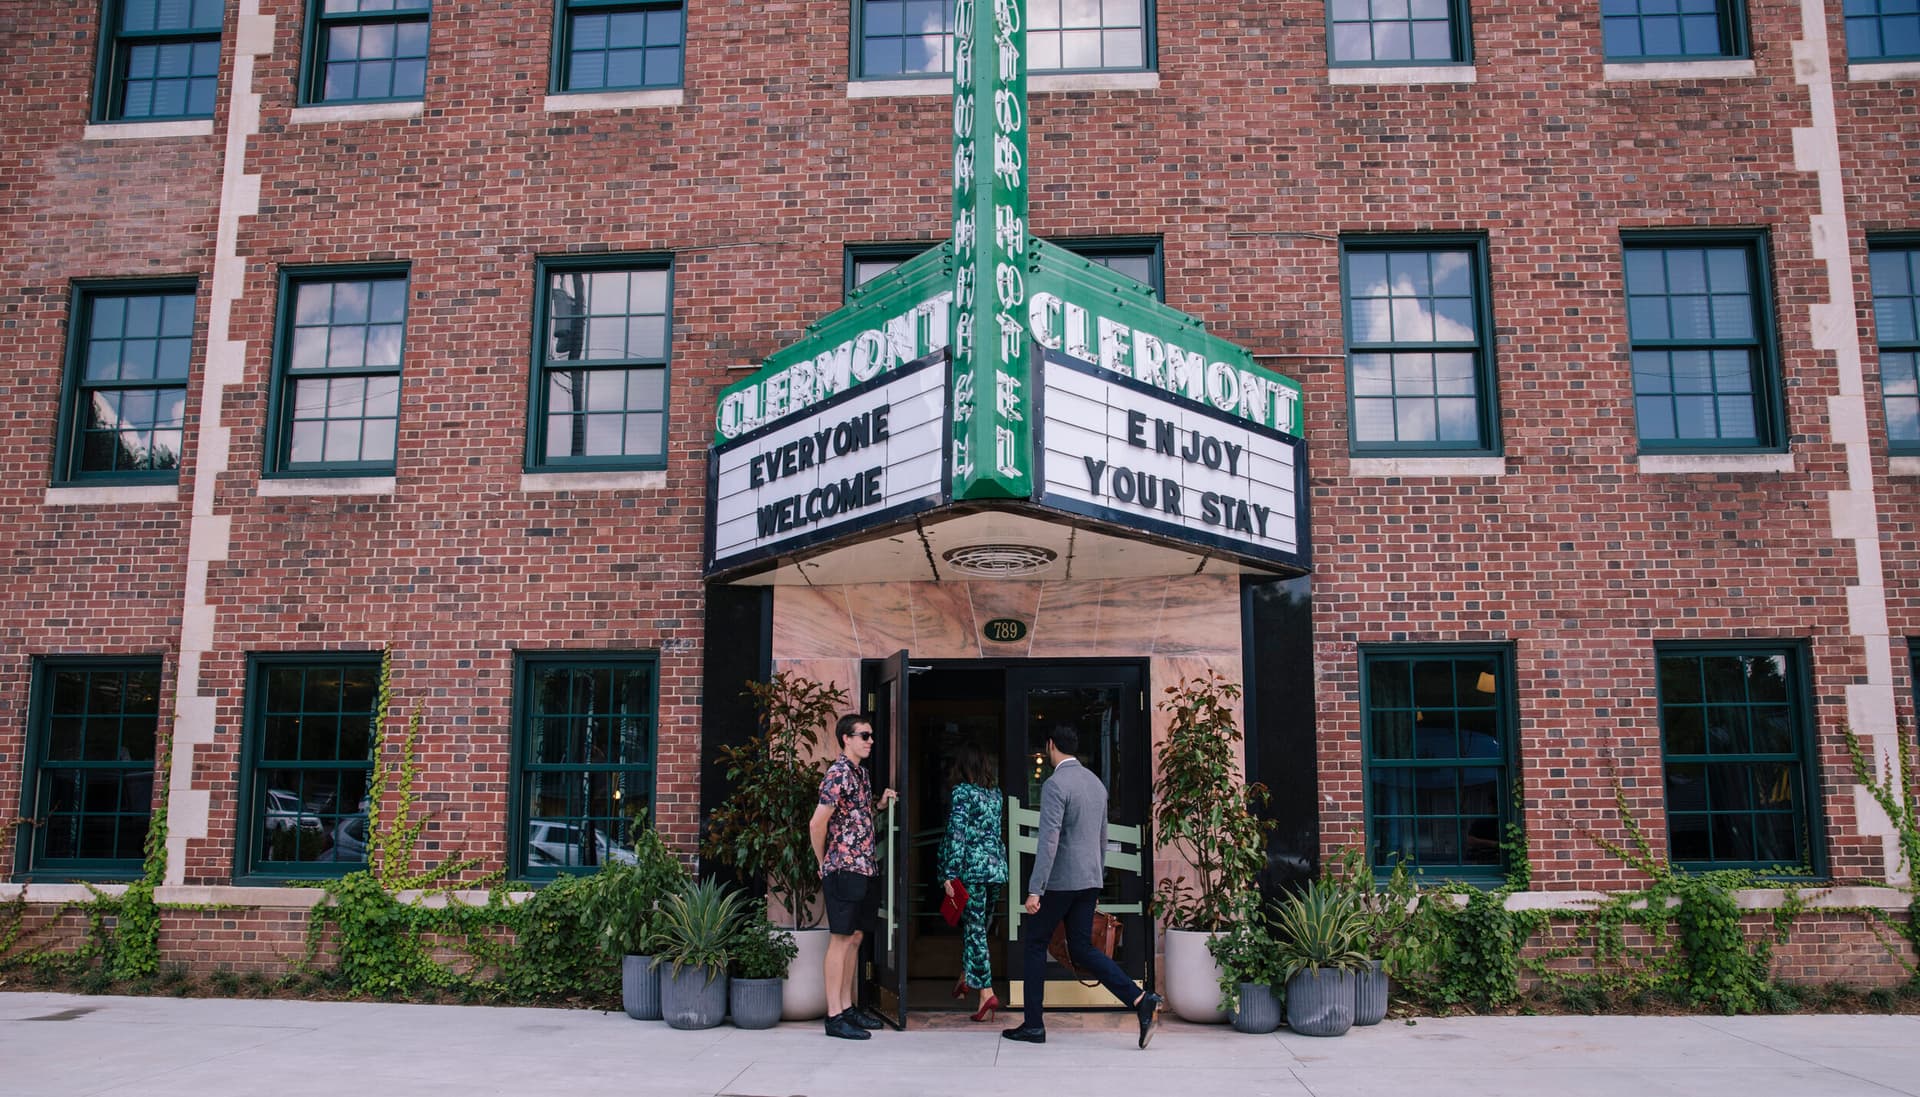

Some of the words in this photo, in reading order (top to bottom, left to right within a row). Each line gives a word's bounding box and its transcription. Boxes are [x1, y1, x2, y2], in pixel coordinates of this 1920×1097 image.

[716, 291, 952, 439] CLERMONT
[1029, 292, 1299, 433] CLERMONT
[750, 403, 890, 490] EVERYONE
[1128, 409, 1242, 476] ENJOY
[757, 465, 882, 538] WELCOME
[1083, 456, 1181, 516] YOUR
[1201, 491, 1270, 537] STAY
[993, 622, 1018, 639] 789
